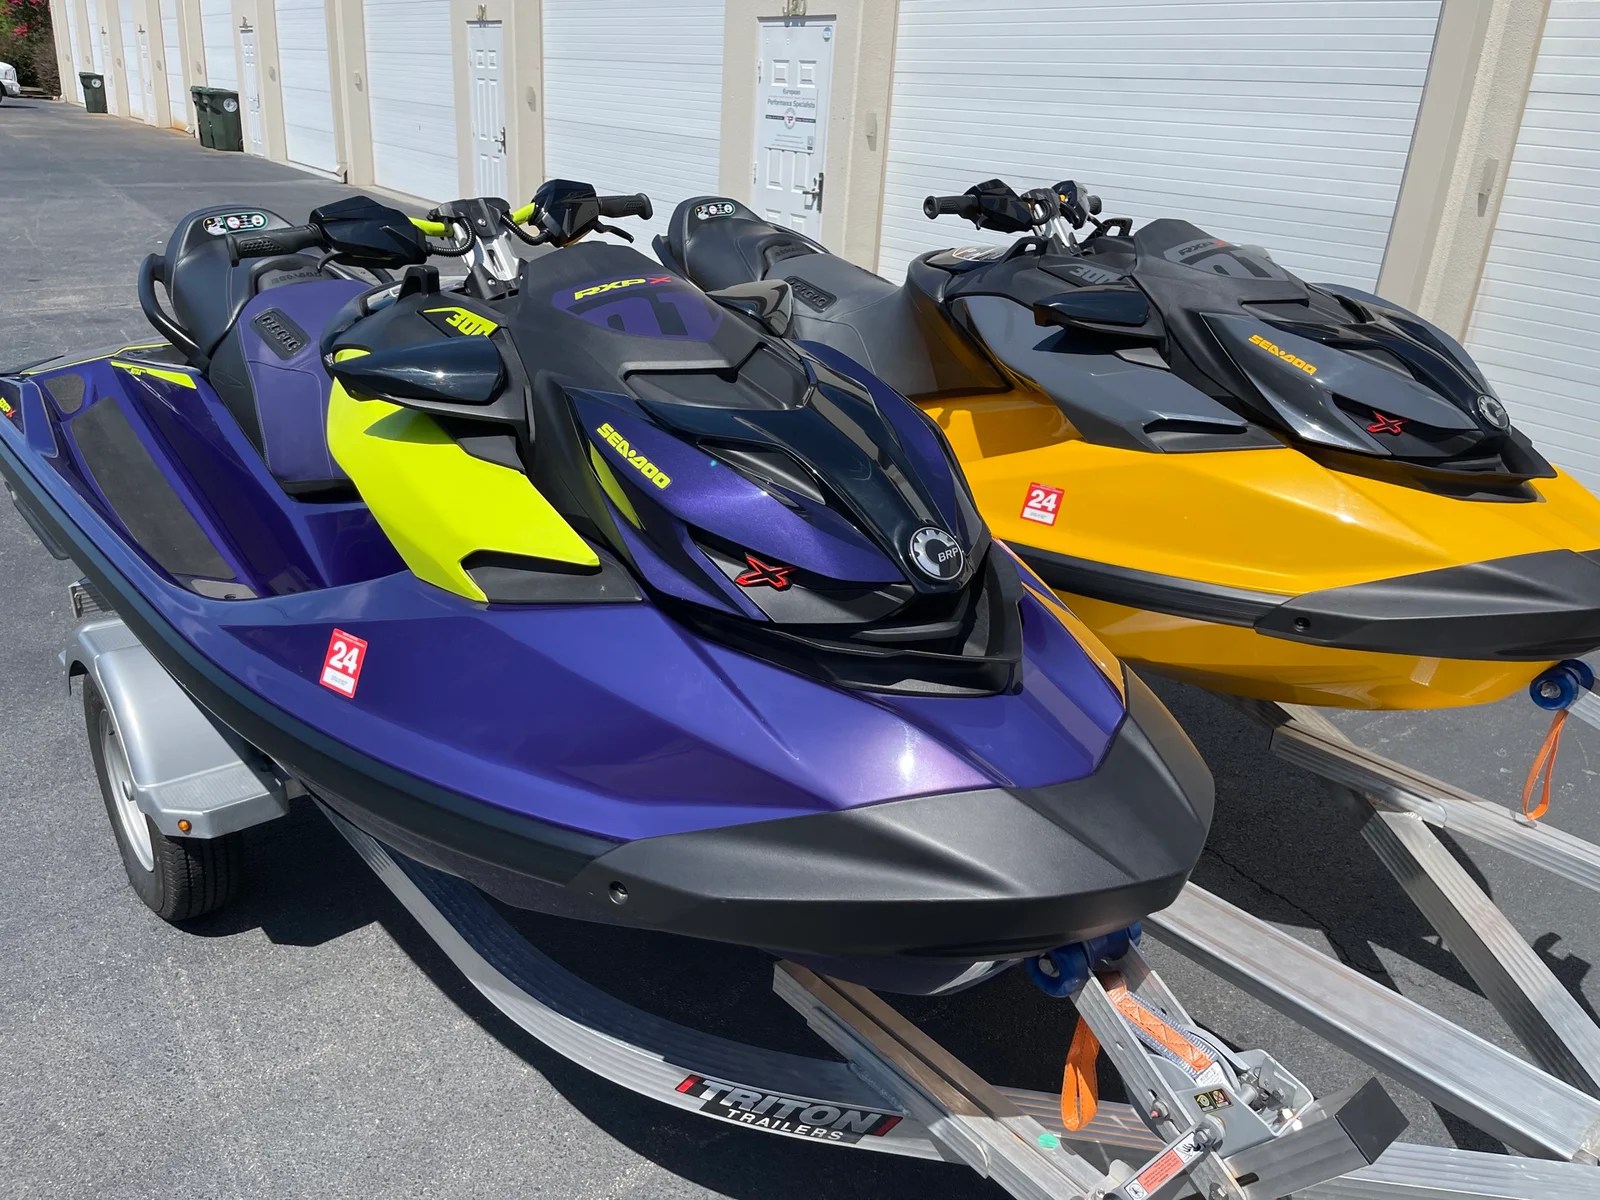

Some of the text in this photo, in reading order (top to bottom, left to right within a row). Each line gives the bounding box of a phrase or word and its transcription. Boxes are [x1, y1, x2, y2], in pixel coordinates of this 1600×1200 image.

[767, 98, 816, 109] Performance Specialists
[1027, 489, 1058, 512] 24
[938, 547, 959, 562] BRP
[329, 641, 360, 674] 24
[699, 1080, 883, 1134] TRITON
[727, 1108, 844, 1141] TRAILERS
